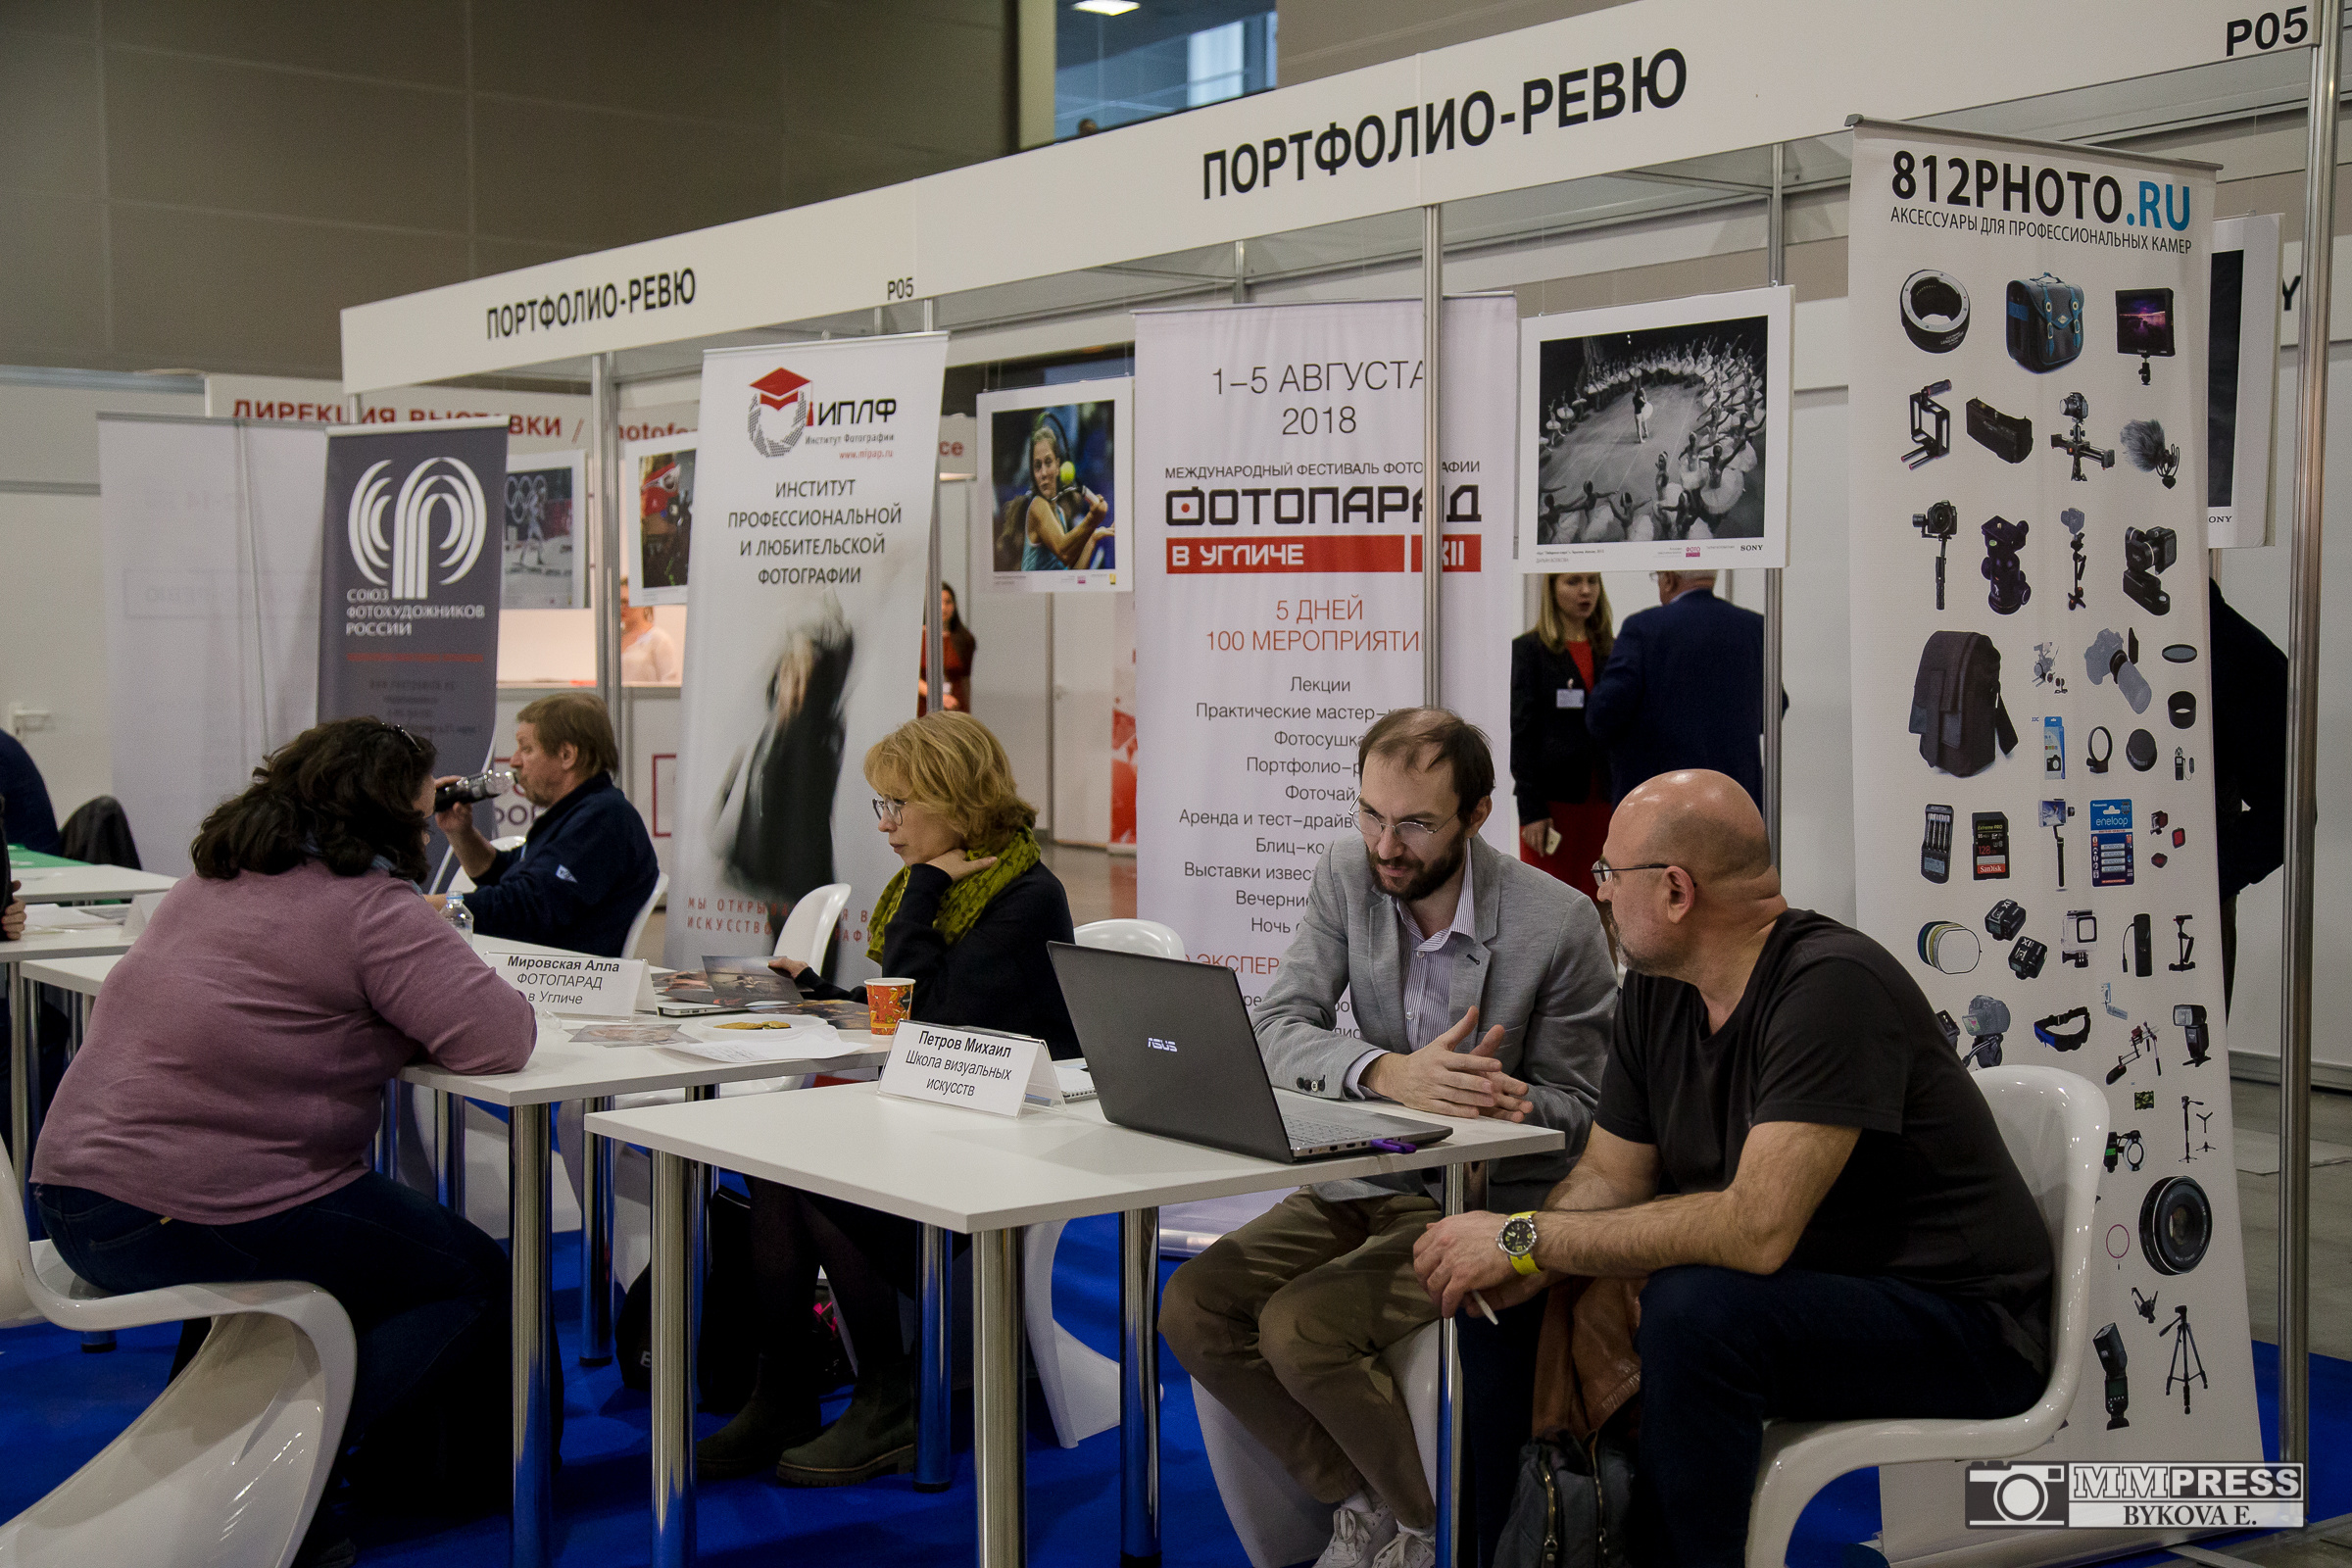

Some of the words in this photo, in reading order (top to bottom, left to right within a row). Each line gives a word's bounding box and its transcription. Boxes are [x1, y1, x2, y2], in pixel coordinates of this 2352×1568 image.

[1202, 47, 1688, 201] ПОРТФОЛИО-РЕВЮ
[1890, 149, 2192, 232] 812PHOTO.RU
[1889, 206, 1979, 232] АКСЕССУАРЫ
[1980, 217, 2006, 236] ДЛЯ
[2008, 220, 2149, 252] ПРОФЕССИОНАЛЬНЫХ
[2151, 237, 2193, 256] КАМЕР
[486, 267, 698, 343] ПОРТФОЛИО-РЕВЮ
[232, 399, 396, 424] ДИРЕКИЯ
[817, 398, 897, 426] ИПЛФ
[1282, 406, 1357, 435] 2018
[805, 435, 841, 446] Институт
[844, 433, 895, 444] Фотографии
[1164, 462, 1294, 479] МЕЖДУНАРОДНЫЙ
[1297, 463, 1380, 477] ФЕСТИВАЛЬ
[1383, 461, 1481, 474] ФОТОАФИИ
[775, 479, 856, 498] ИНСТИТУТ
[727, 503, 903, 528] ПРОФЕССИОНАЛЬНОЙ
[740, 540, 752, 556] И
[756, 533, 886, 557] ЛЮБИТЕЛЬСКОЙ
[1172, 546, 1190, 566] В
[1200, 544, 1304, 566] УГЛИЧЕ
[758, 566, 861, 585] ФОТОГРАФИИ
[346, 588, 390, 604] СОЮЗ
[346, 603, 486, 620] ФОТОХУДОЖНИКОВ
[1276, 600, 1290, 621] 5
[1296, 594, 1364, 624] ДНЕЙ
[345, 621, 413, 637] РОССИИ
[1205, 630, 1246, 652] 100
[1252, 630, 1424, 652] МЕРОПРИЯТИ
[1290, 676, 1351, 694] Лекции
[1196, 703, 1311, 722] Практические
[1316, 707, 1396, 723] мастер–
[1246, 757, 1359, 777] Портфолио–р
[1284, 785, 1356, 802] Фоточай
[1178, 808, 1240, 828] Аренда
[1244, 814, 1253, 825] и
[2095, 816, 2129, 827] eneloop
[1255, 837, 1325, 856] Блиц–ко
[1978, 845, 1991, 855] 128
[1184, 861, 1262, 879] Выставки
[1265, 867, 1314, 881] извес
[687, 897, 708, 910] МЫ
[716, 900, 796, 917] ОТКРЫВА
[1236, 889, 1309, 909] Вечерни
[687, 914, 772, 936] ИСКУССТВО
[1250, 916, 1292, 934] Ночь
[508, 956, 581, 970] Мировская
[584, 960, 620, 973] Алла
[1196, 953, 1280, 975] ЭКСПЕР
[516, 973, 603, 990] ФОТОПАРАД
[527, 992, 535, 1002] в
[539, 990, 583, 1005] Угличе
[918, 1030, 962, 1054] Петров
[964, 1038, 1012, 1059] Михаил
[1148, 1037, 1178, 1053] ASUS
[905, 1050, 942, 1069] Школа
[943, 1059, 1013, 1081] визуальных
[925, 1076, 976, 1097] искусств
